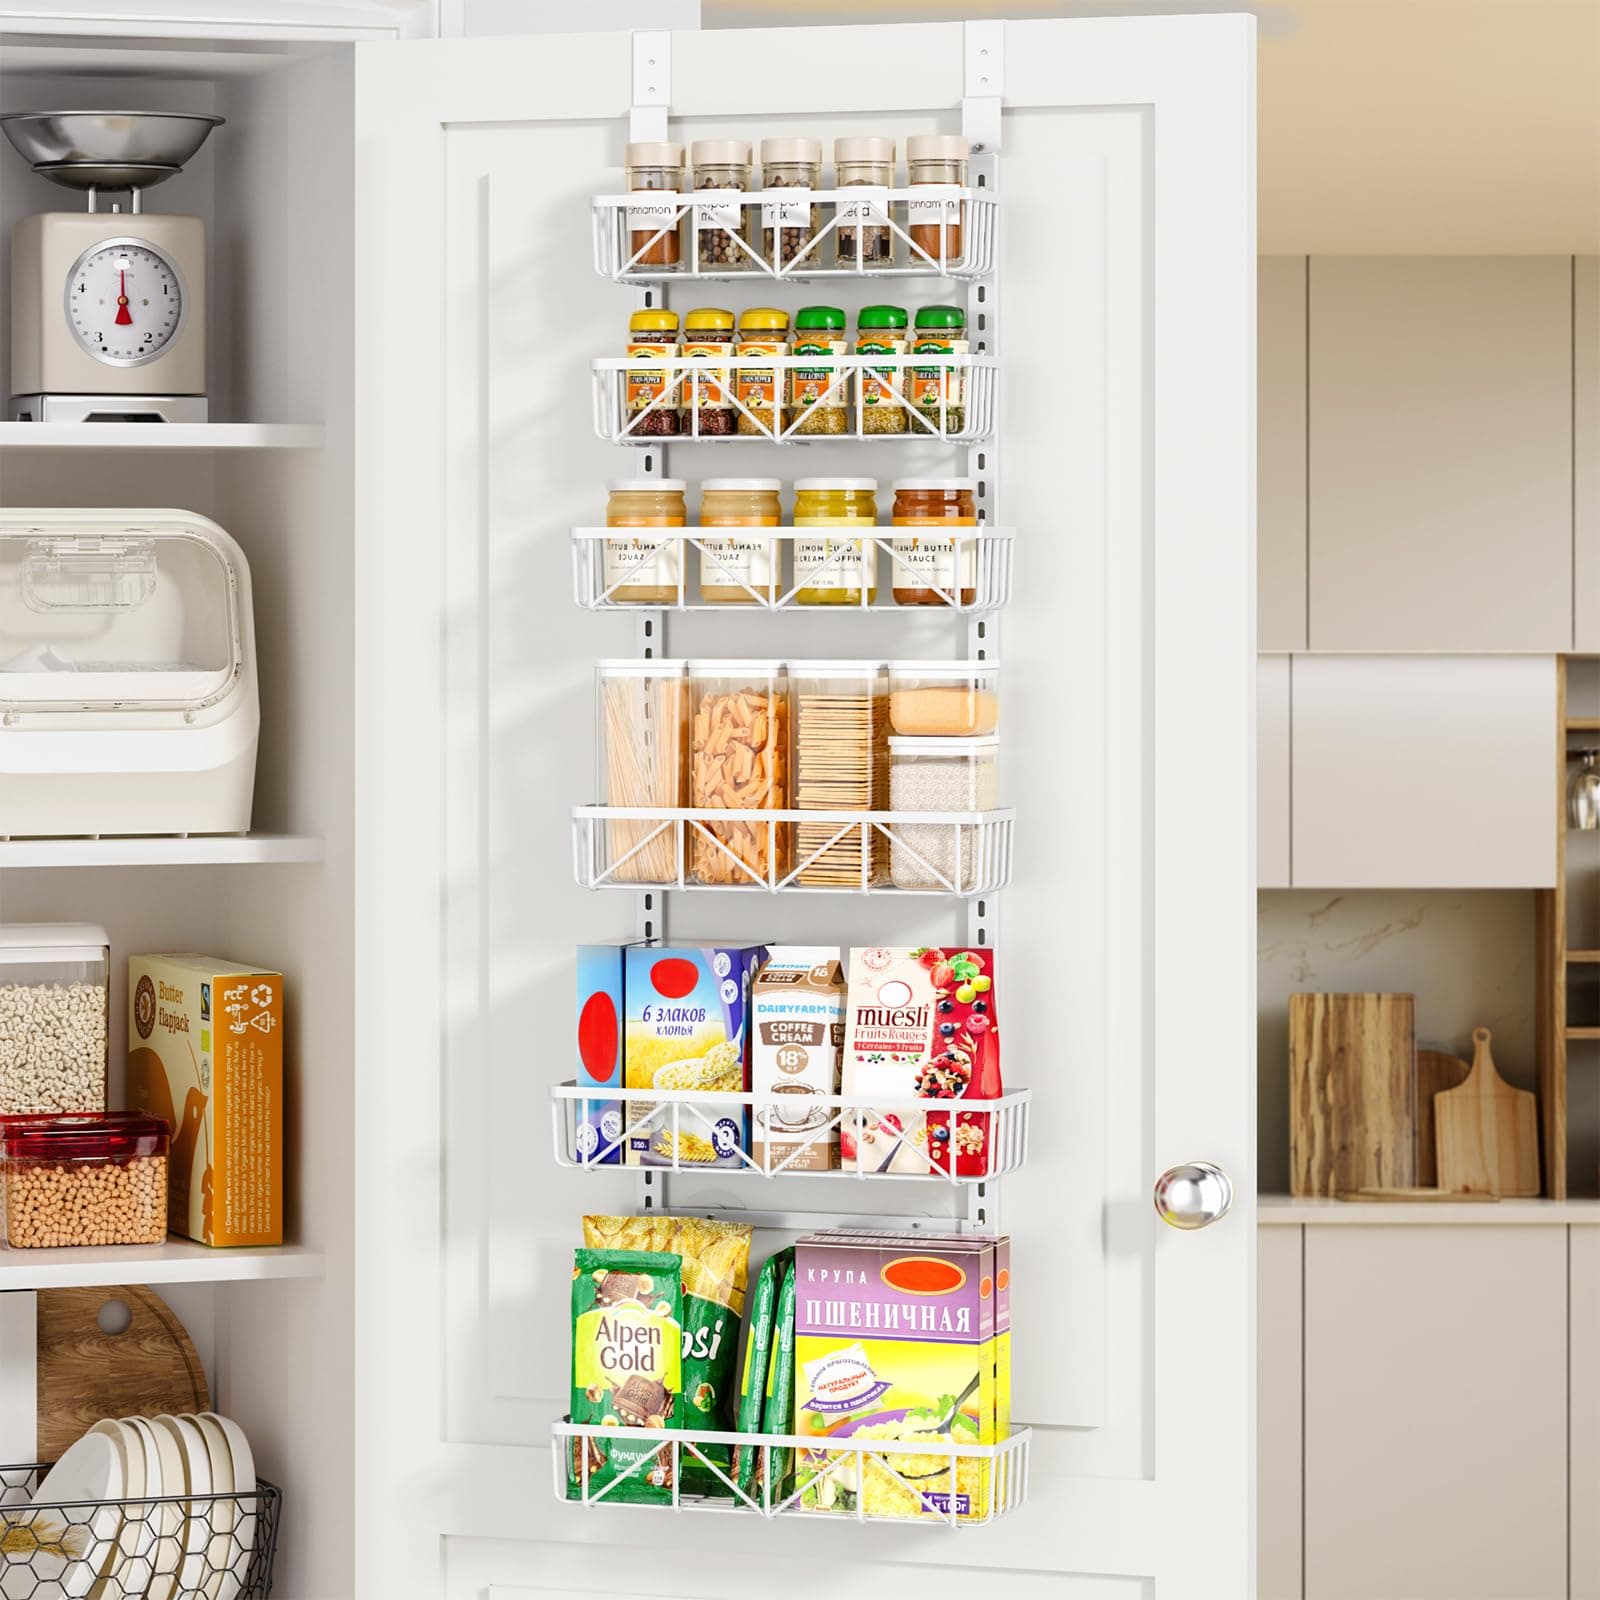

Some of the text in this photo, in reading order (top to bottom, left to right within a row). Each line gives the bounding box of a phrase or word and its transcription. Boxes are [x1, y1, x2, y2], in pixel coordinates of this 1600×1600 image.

[78, 283, 87, 293] 4
[163, 284, 168, 295] 1
[94, 331, 103, 343] 3
[143, 332, 153, 343] 2
[907, 555, 936, 563] SAUCE
[159, 980, 184, 1004] Butter
[642, 1005, 706, 1023] 6 злаков
[757, 1004, 826, 1014] DAIRYFARM
[856, 1004, 929, 1027] muesli
[159, 1007, 190, 1035] flapjack
[770, 1022, 815, 1033] COFFEE
[655, 1025, 694, 1036] хлопья
[854, 1028, 928, 1042] Fruits Rouges
[771, 1032, 813, 1043] CREAM
[807, 1268, 868, 1285] КРУПА
[805, 1299, 972, 1333] ПШЕНИЧНАЯ
[595, 1316, 661, 1350] Alpen
[600, 1346, 656, 1372] Gold
